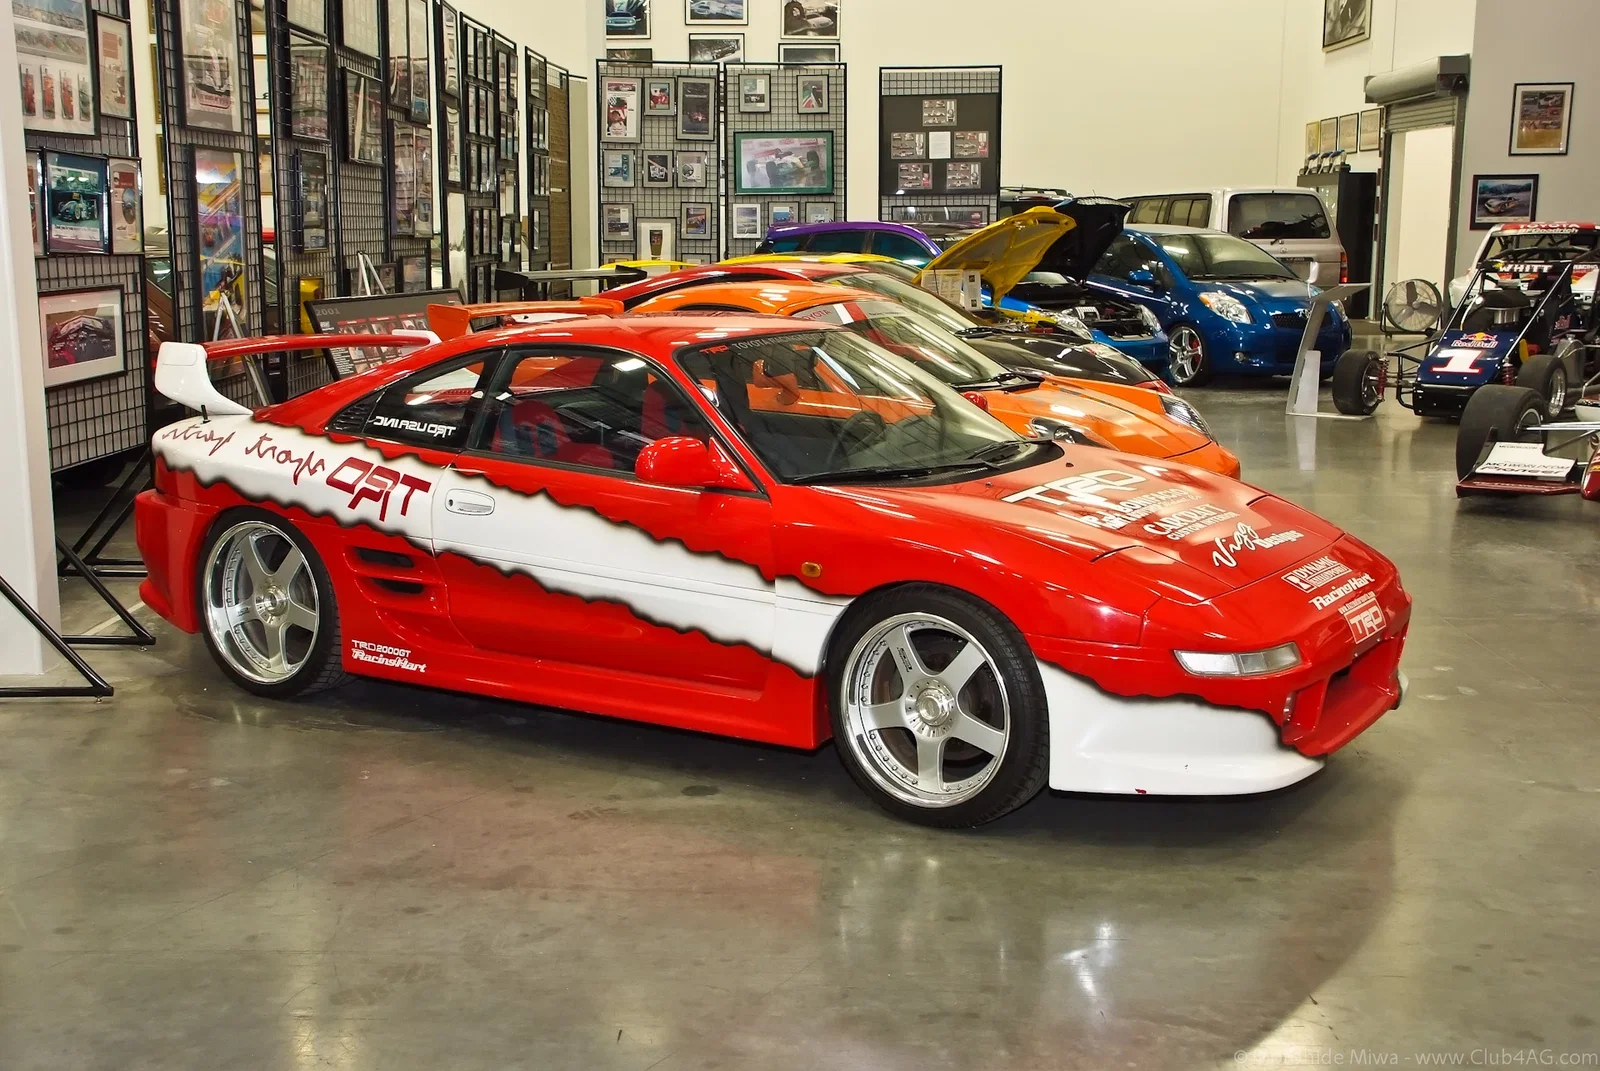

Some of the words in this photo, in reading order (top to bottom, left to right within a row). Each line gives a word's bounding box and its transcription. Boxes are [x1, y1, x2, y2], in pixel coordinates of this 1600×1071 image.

[1499, 263, 1554, 273] WHITT
[315, 307, 341, 317] 2001
[731, 338, 770, 350] TOYOTA
[1430, 348, 1485, 375] 1
[1479, 466, 1566, 475] Pioneer
[1001, 469, 1147, 509] TRD
[1252, 529, 1305, 549] Designs
[1292, 556, 1338, 579] DYNAMIC
[1349, 605, 1383, 637] TRD
[351, 639, 377, 651] TRD
[376, 646, 412, 658] 2000GT
